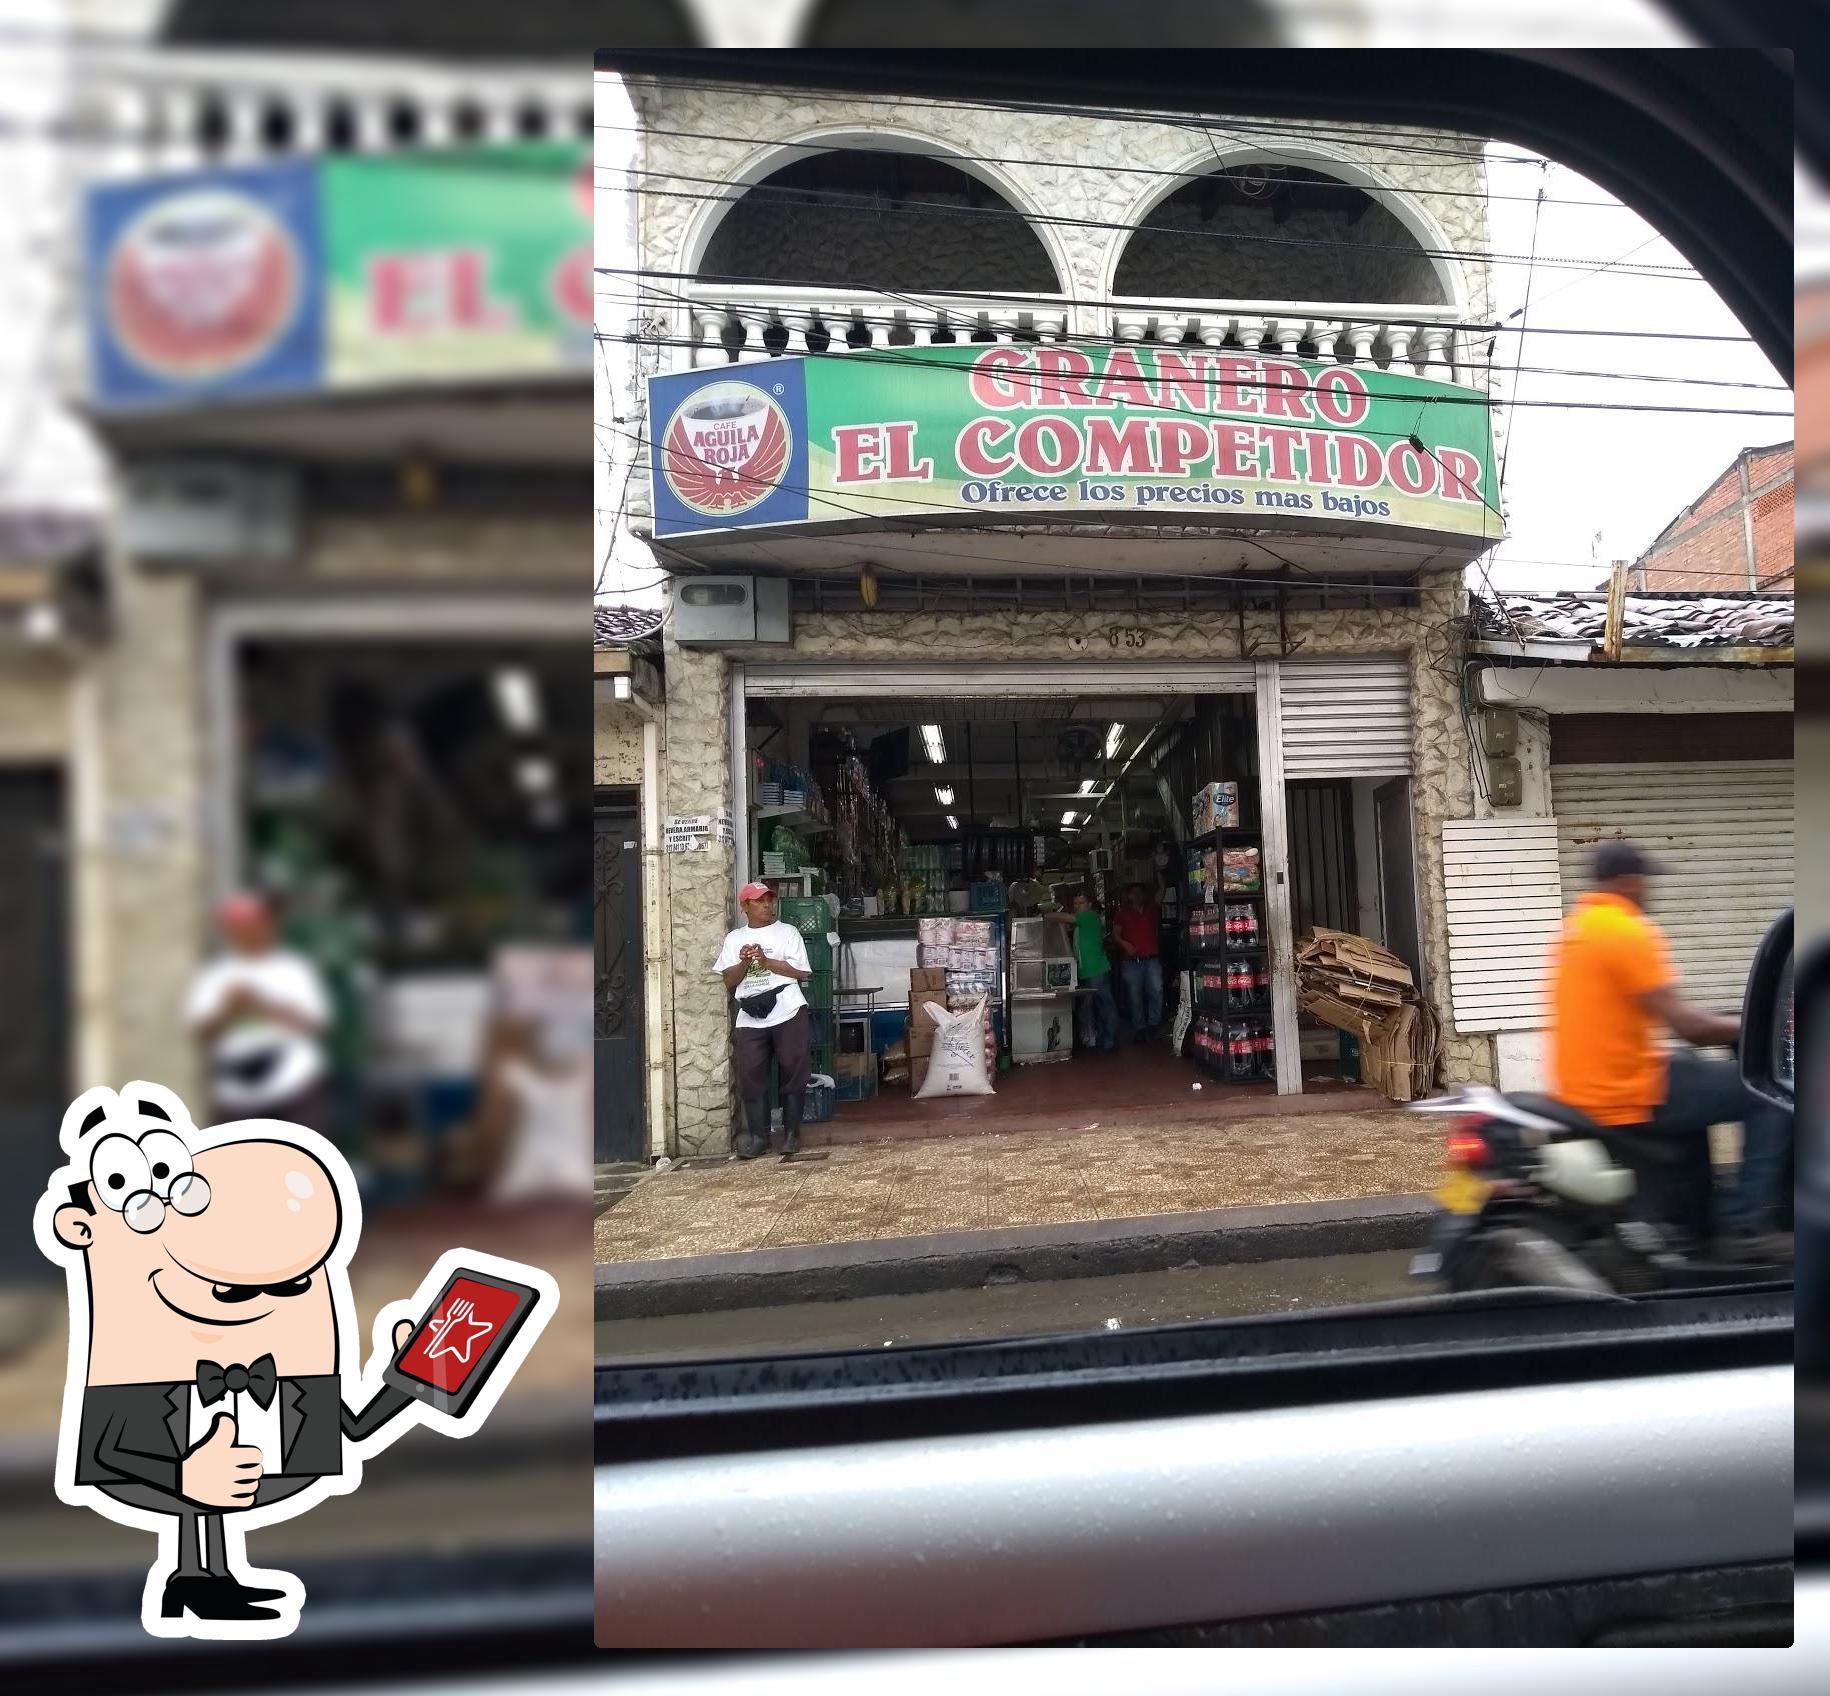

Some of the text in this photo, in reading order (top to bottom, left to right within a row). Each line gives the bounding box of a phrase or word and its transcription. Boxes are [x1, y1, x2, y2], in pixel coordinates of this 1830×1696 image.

[969, 346, 1369, 426] GRANERO
[693, 424, 760, 448] AGUILA
[713, 420, 737, 431] CAFE
[703, 445, 750, 467] ROJA
[832, 416, 1485, 504] EL COMPETIDOR
[961, 479, 1390, 518] Ofrece los precios mas bajos
[1216, 794, 1235, 803] Elite
